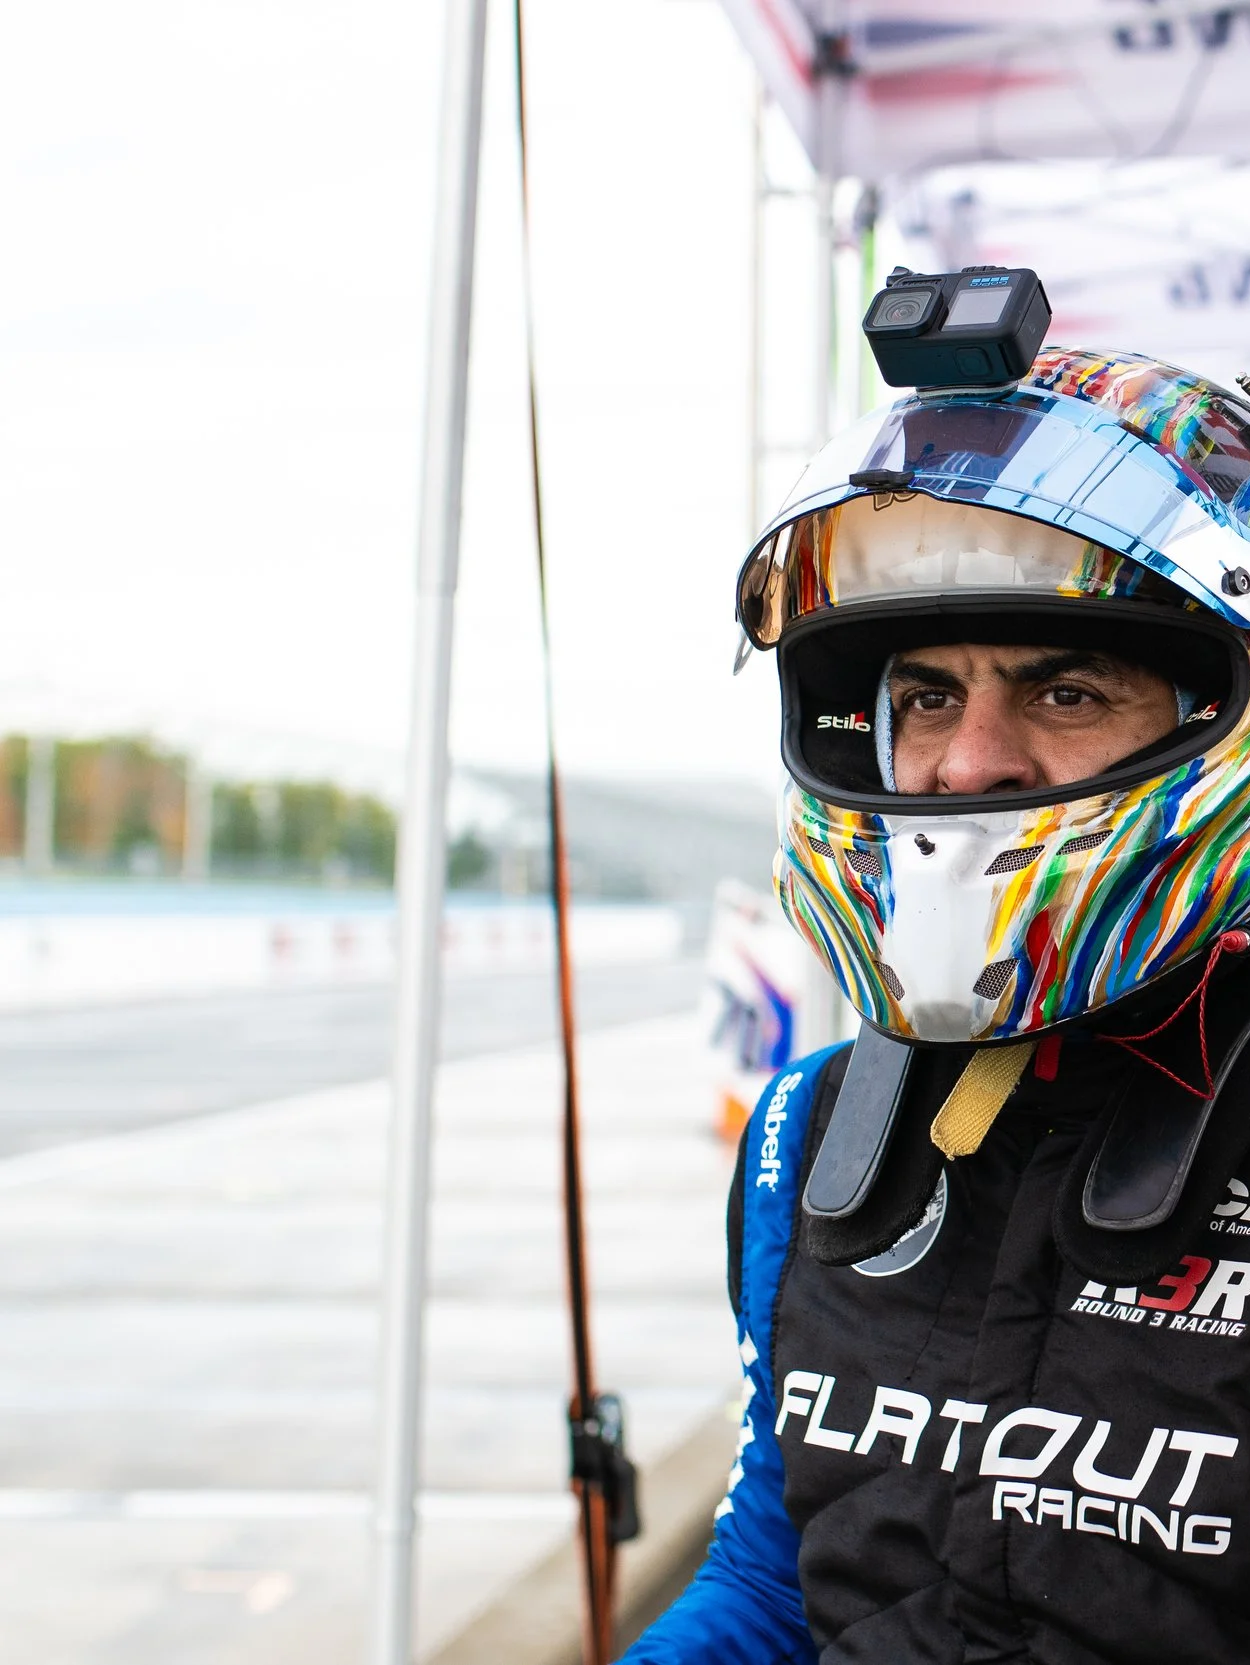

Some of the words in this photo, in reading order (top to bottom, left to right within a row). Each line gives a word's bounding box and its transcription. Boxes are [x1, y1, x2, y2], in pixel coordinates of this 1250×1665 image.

[970, 279, 1008, 287] GoPro
[756, 1071, 804, 1189] Sabelt
[1209, 1219, 1226, 1232] of
[1070, 1297, 1147, 1323] ROUND
[1148, 1312, 1166, 1327] 3
[1168, 1314, 1248, 1337] RACING
[774, 1370, 1240, 1508] FLATOUT
[992, 1480, 1233, 1556] RACING
